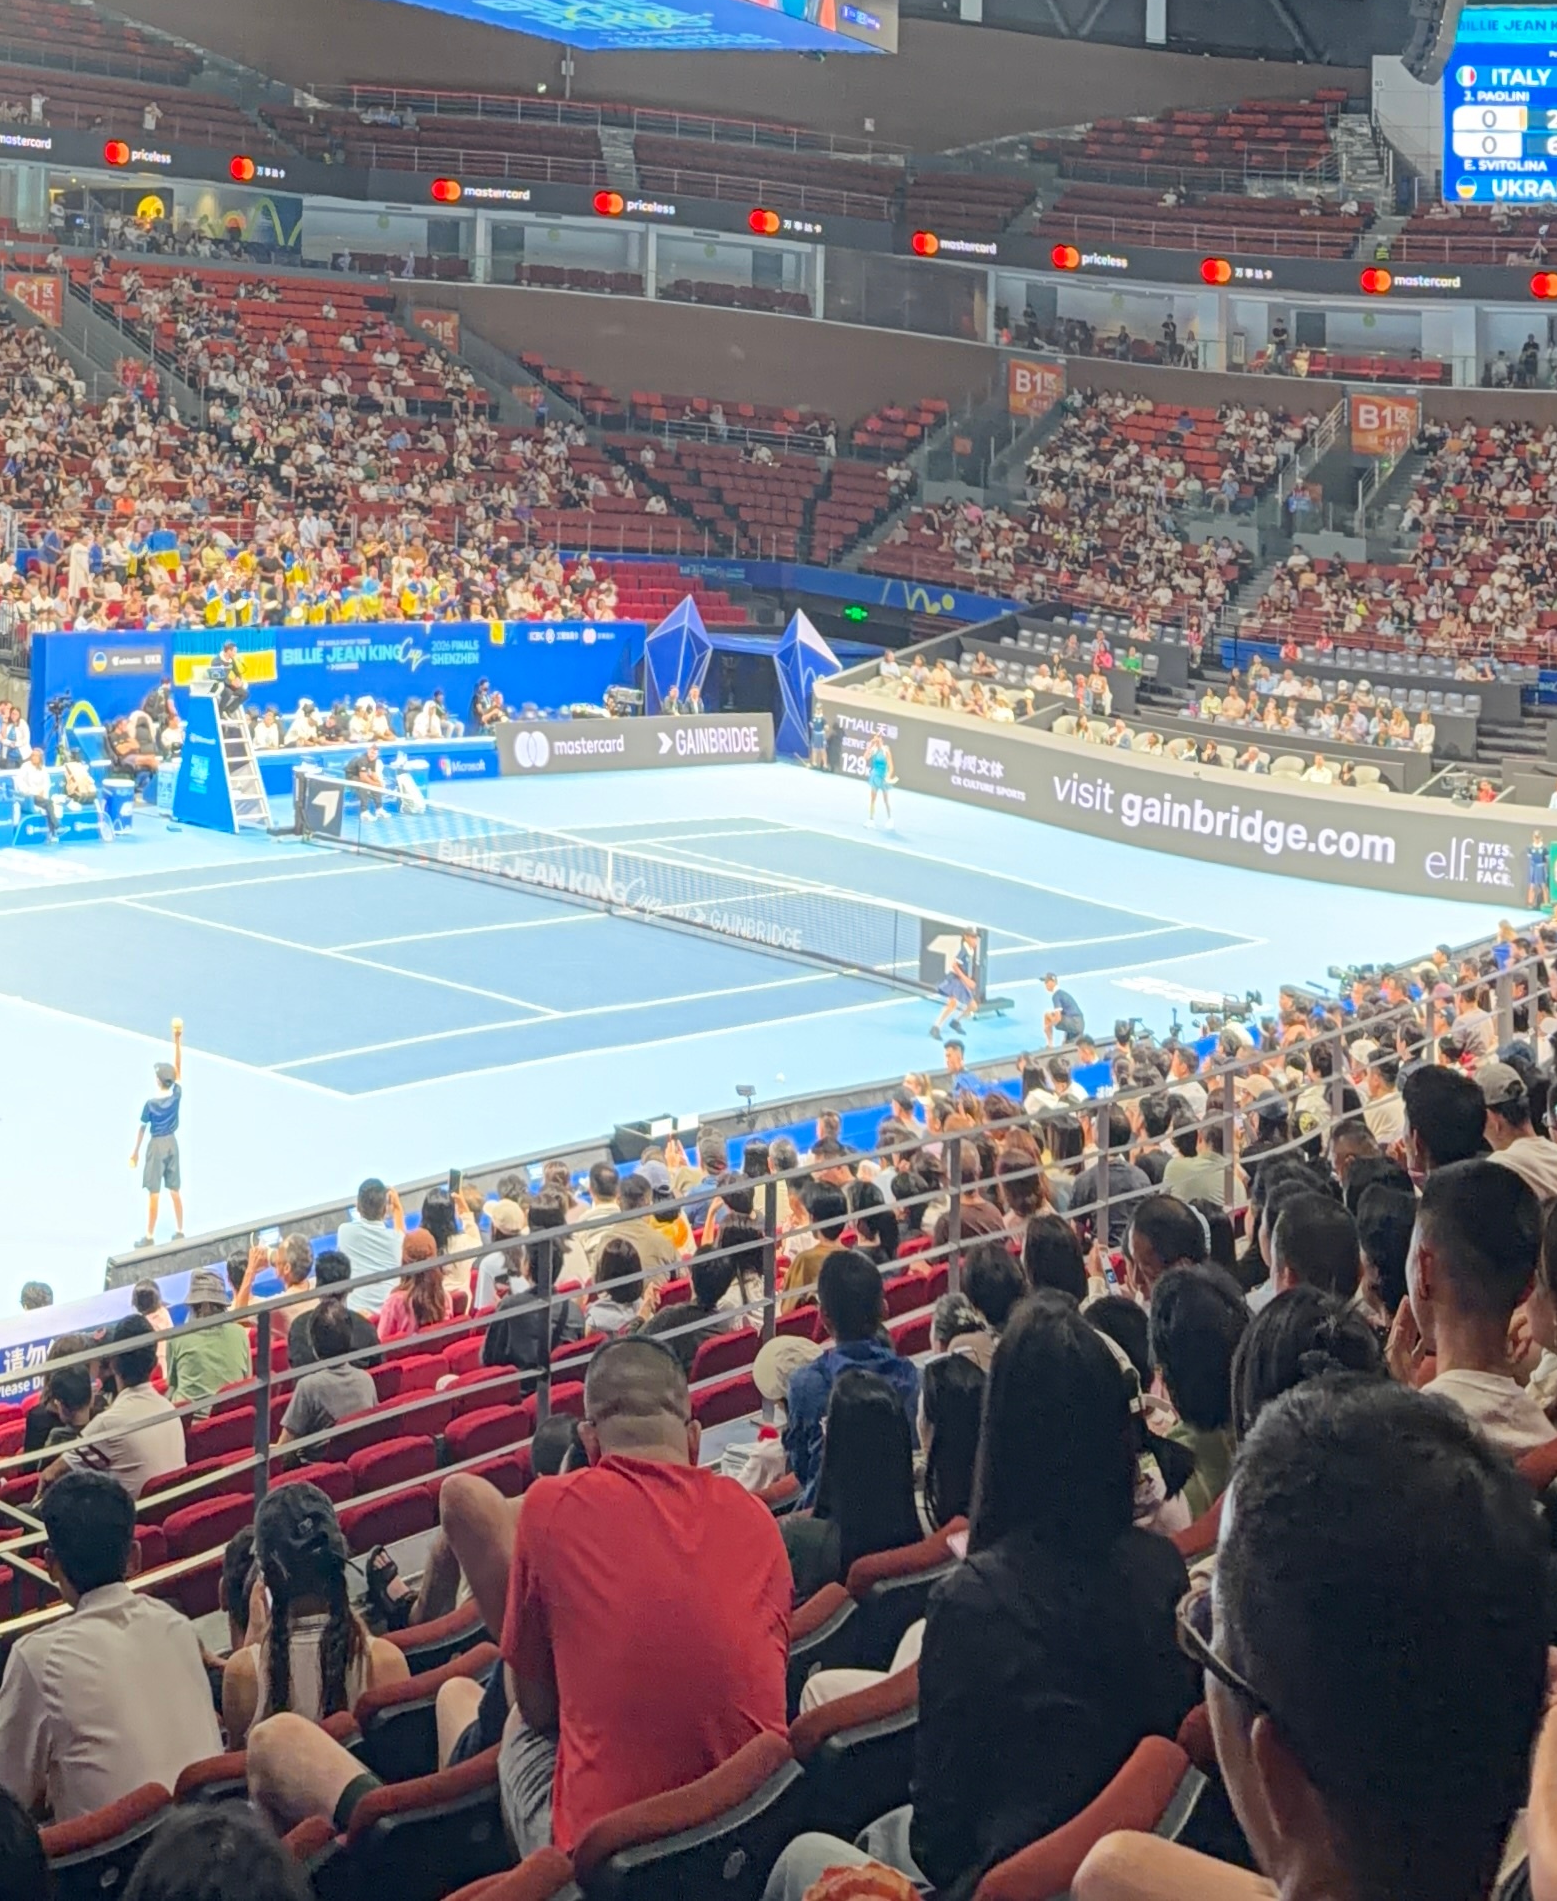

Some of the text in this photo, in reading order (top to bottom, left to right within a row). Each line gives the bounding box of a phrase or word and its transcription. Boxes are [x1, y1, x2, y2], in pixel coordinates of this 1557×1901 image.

[1503, 19, 1548, 31] JEAN
[1491, 67, 1552, 86] ITALY
[1478, 90, 1530, 102] PAOLINI
[1481, 109, 1497, 128] 0
[1481, 135, 1497, 154] 0
[131, 148, 172, 164] priceless
[1478, 159, 1548, 172] SVITOLINA
[463, 187, 531, 201] mastercard
[626, 199, 676, 215] priceless
[940, 240, 997, 256] mastercard
[1081, 252, 1128, 269] priceless
[1393, 275, 1461, 288] mastercard
[452, 640, 480, 651] FINALS
[281, 648, 324, 666] BILLIE
[327, 647, 366, 664] JEAN
[368, 646, 403, 662] KING
[431, 652, 480, 666] SHENZHEN
[553, 734, 625, 756] mastercard
[675, 727, 760, 756] GAINBRIDGE
[1051, 772, 1396, 865] visit gainbridge.com
[438, 841, 501, 874] BILLIE
[506, 855, 565, 890] JEAN
[569, 868, 627, 904] KING
[710, 910, 803, 951] GAINBRIDGE
